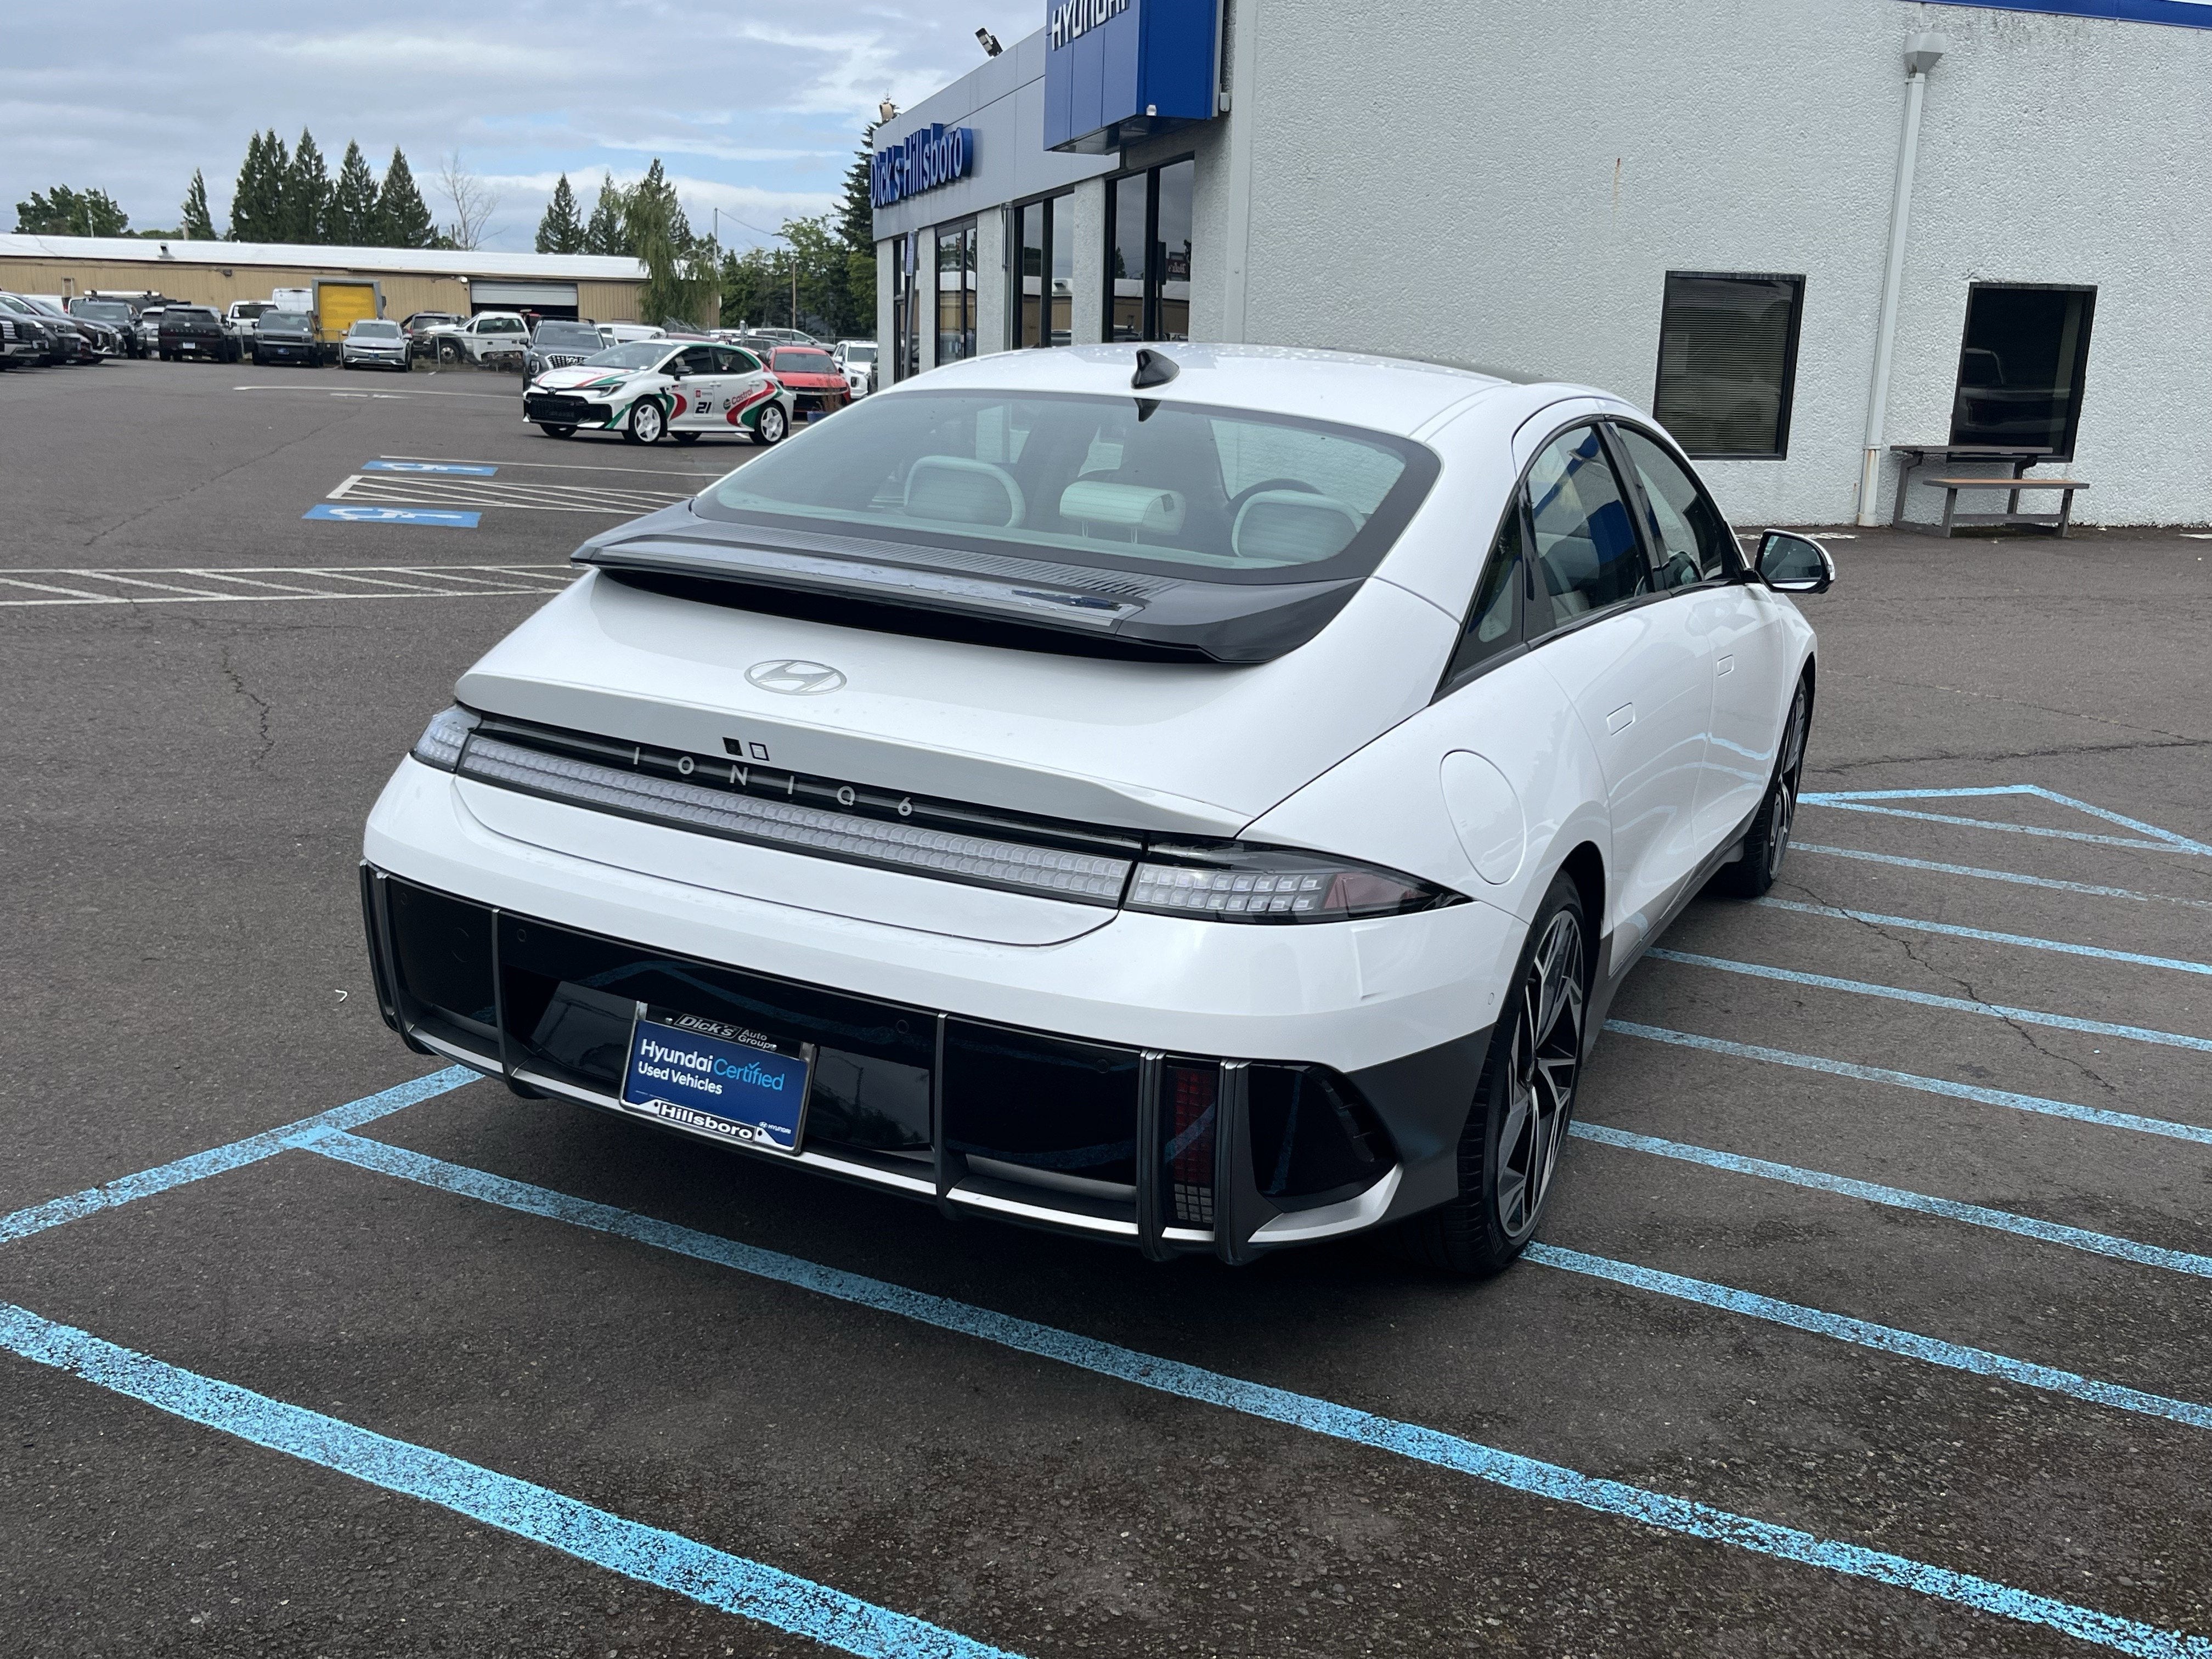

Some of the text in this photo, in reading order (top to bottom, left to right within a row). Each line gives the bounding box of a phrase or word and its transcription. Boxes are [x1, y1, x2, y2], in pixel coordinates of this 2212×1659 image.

[1052, 0, 1126, 51] HYUNDA
[871, 123, 964, 209] Dick's Hillsboro
[695, 402, 712, 414] 21
[731, 387, 753, 405] Castrol
[633, 747, 856, 806] IONIQ
[679, 1016, 768, 1041] Dick's Auto
[738, 1035, 771, 1049] Group
[638, 1061, 723, 1095] Used Vehicles
[640, 1039, 785, 1091] Hyundai Certified
[661, 1104, 753, 1139] Hillsboro
[768, 1124, 792, 1135] HYUNDAI
